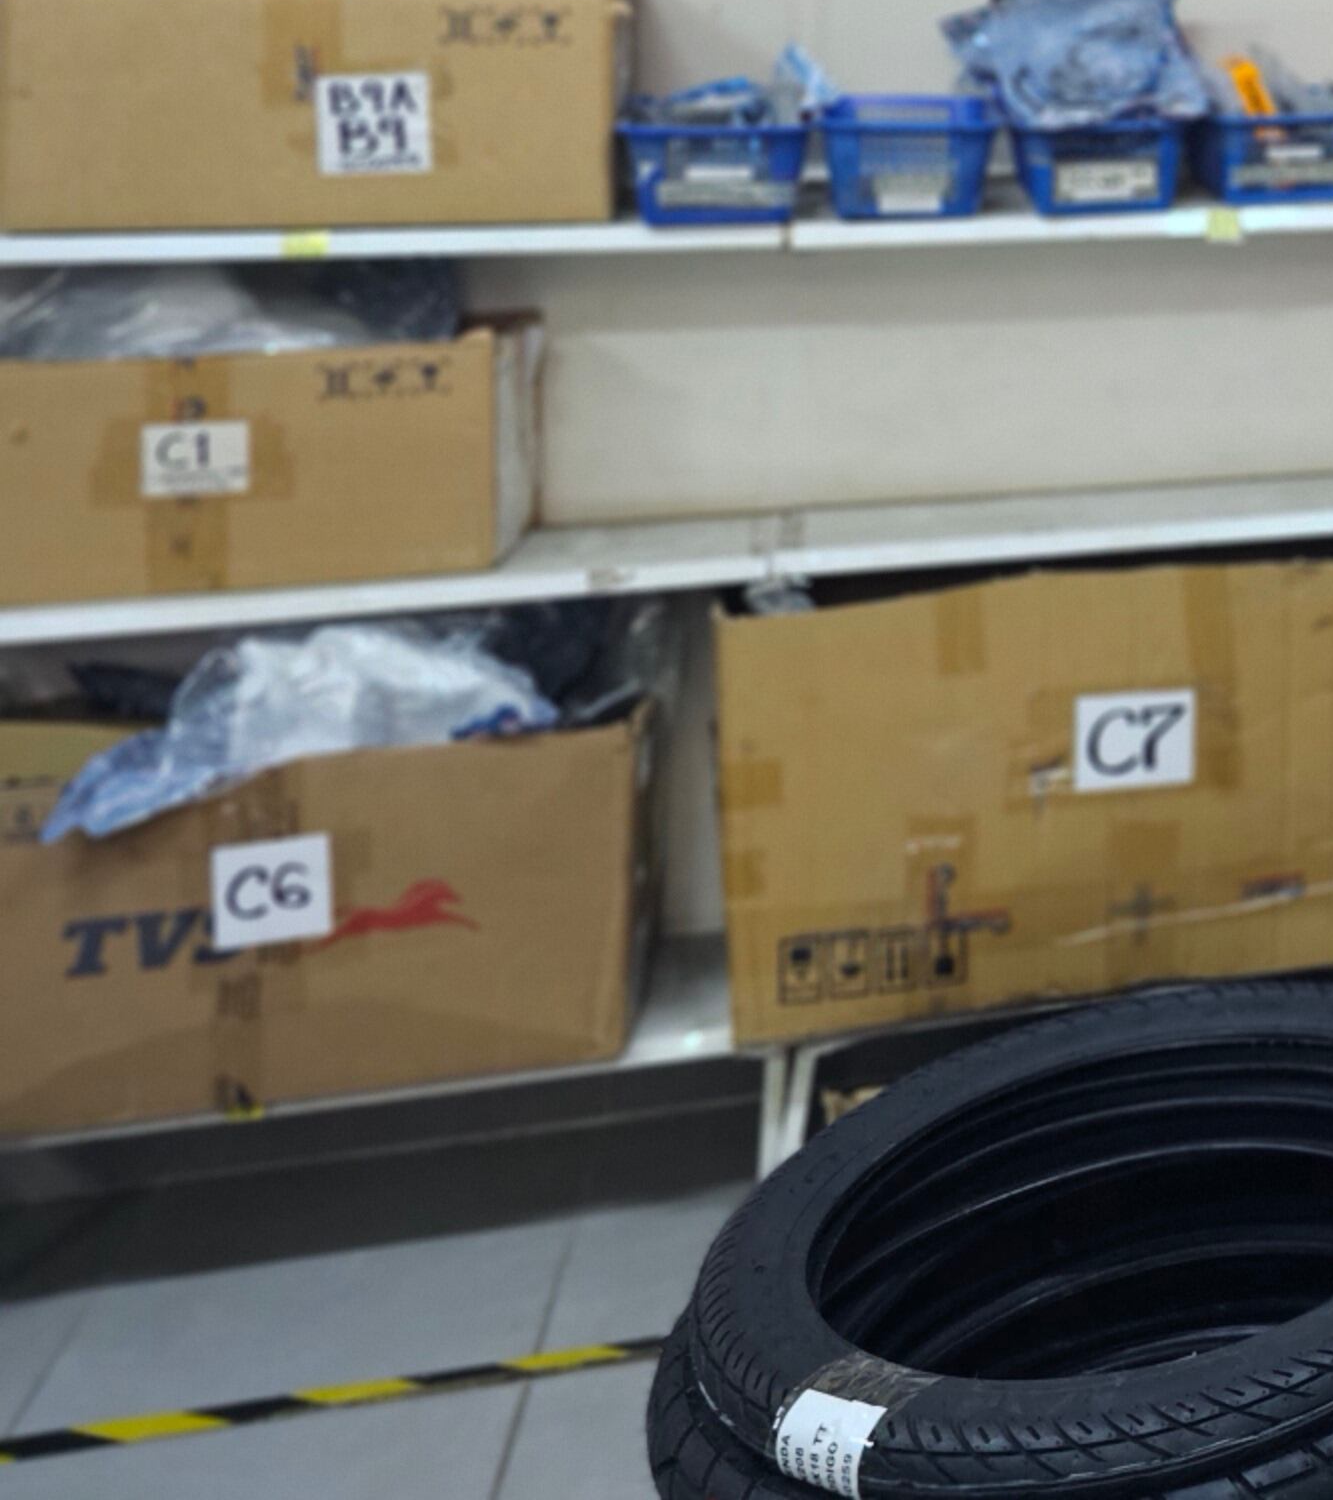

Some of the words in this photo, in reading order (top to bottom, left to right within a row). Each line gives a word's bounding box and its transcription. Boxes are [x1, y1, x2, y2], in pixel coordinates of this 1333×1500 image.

[155, 433, 210, 470] C1
[1086, 705, 1187, 779] C7
[225, 863, 311, 921] C6
[813, 1422, 827, 1446] TT
